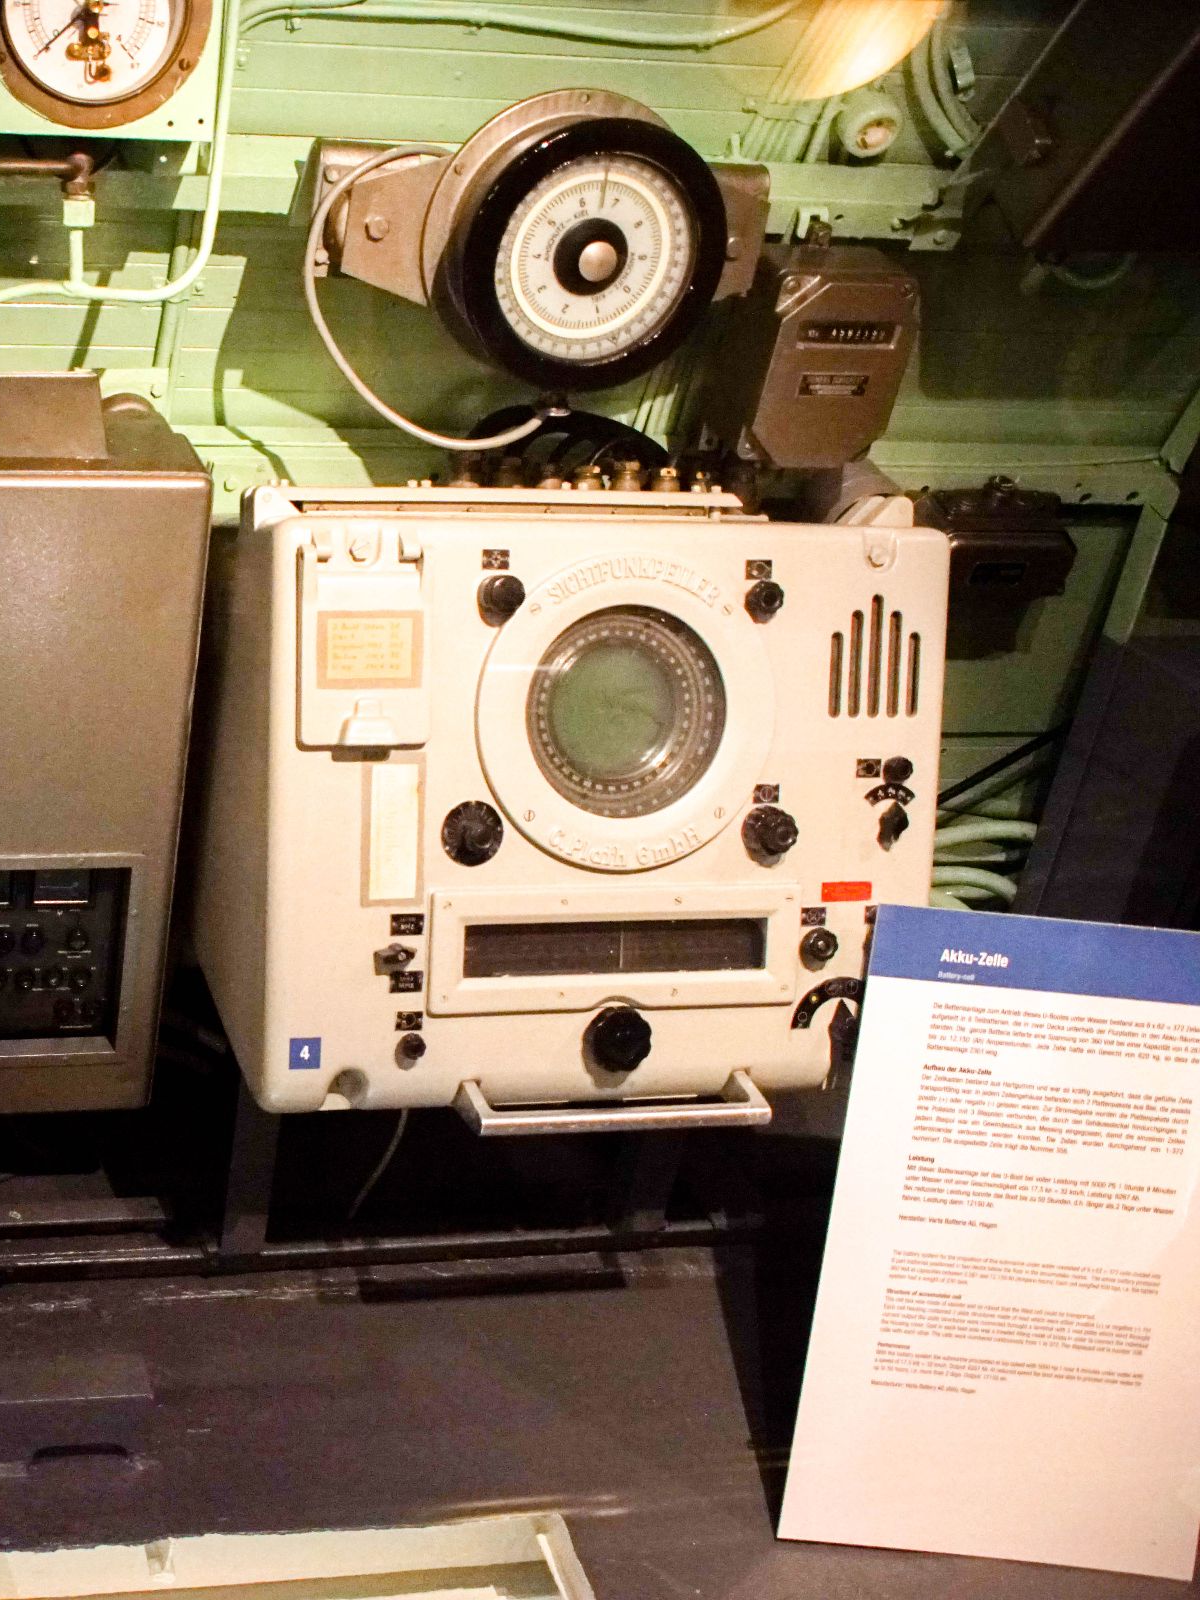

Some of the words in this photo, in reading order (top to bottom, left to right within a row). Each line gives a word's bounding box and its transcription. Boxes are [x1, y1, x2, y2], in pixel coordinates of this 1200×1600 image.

[579, 197, 586, 208] 6
[612, 197, 620, 208] 7
[547, 219, 556, 228] 5
[537, 284, 547, 294] 3
[561, 303, 570, 314] 2
[546, 555, 722, 609] SICHTFUNKPEILER
[634, 824, 703, 867] GmbH
[940, 948, 1009, 969] Akku-Zelle
[299, 1044, 311, 1061] 4
